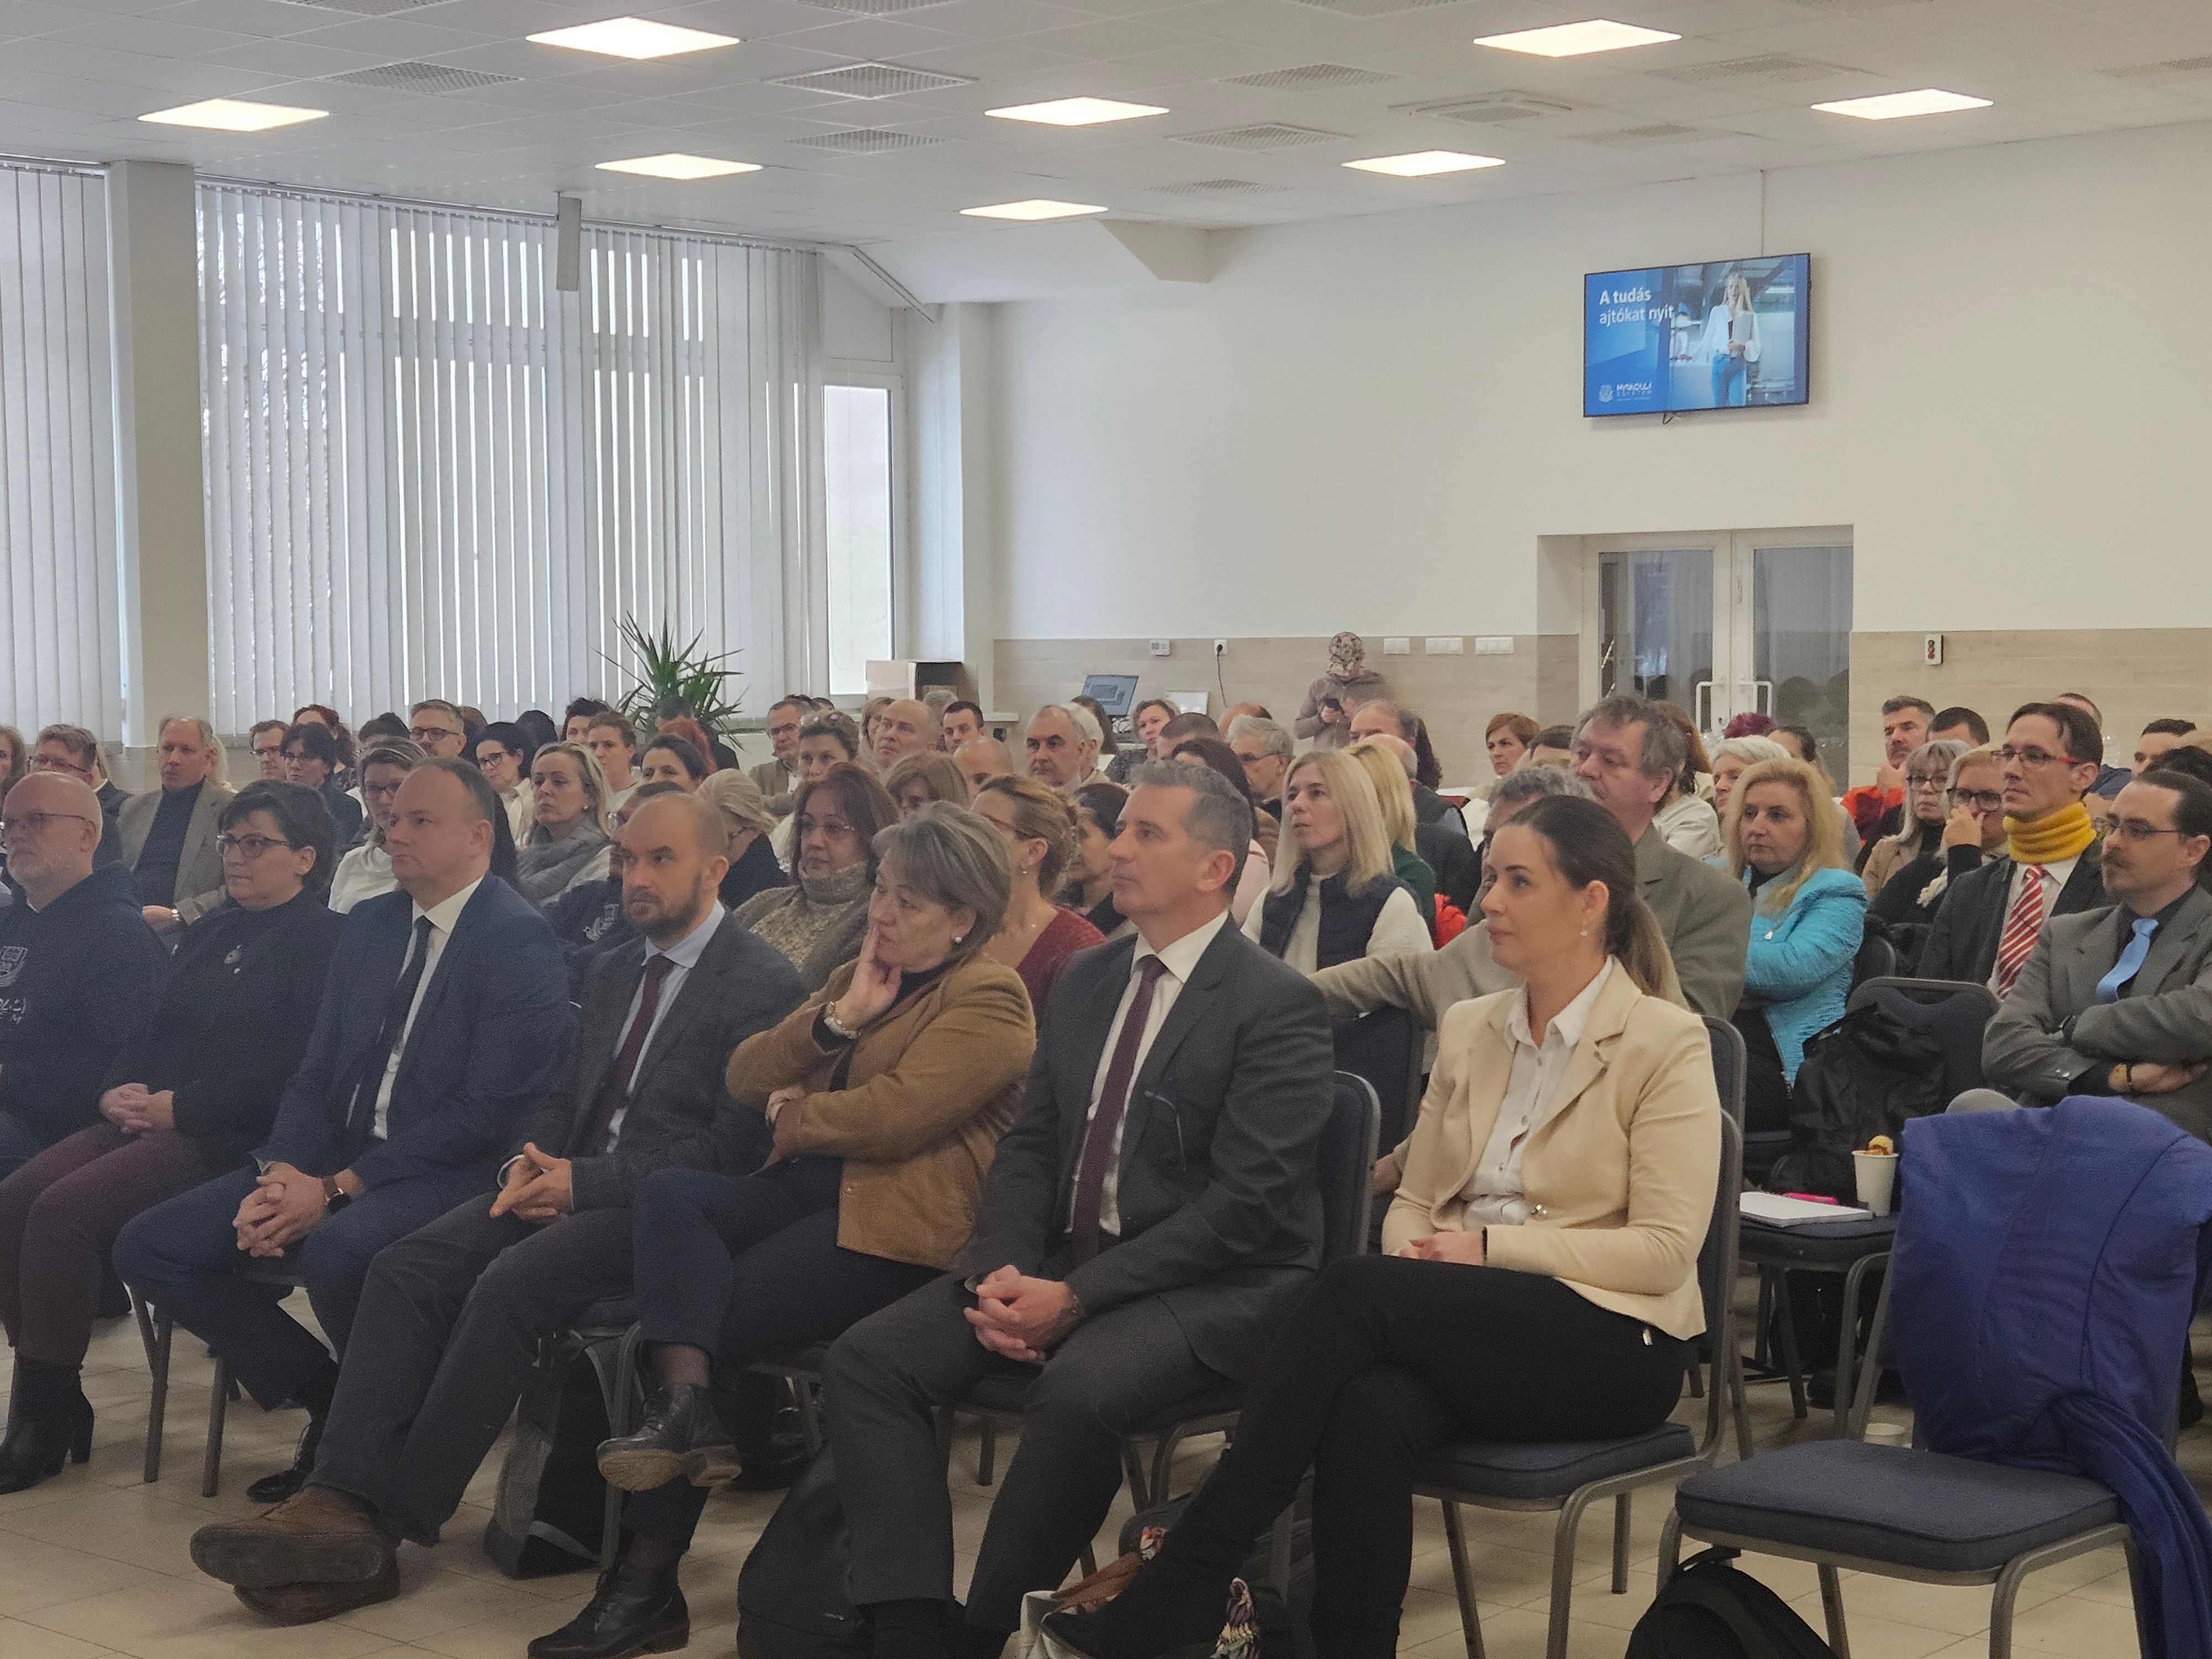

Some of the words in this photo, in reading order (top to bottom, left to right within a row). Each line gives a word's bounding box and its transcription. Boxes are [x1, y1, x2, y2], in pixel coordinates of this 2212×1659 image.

[1599, 290, 1610, 305] A
[1613, 287, 1651, 304] tudás
[1599, 307, 1646, 327] ajtókat
